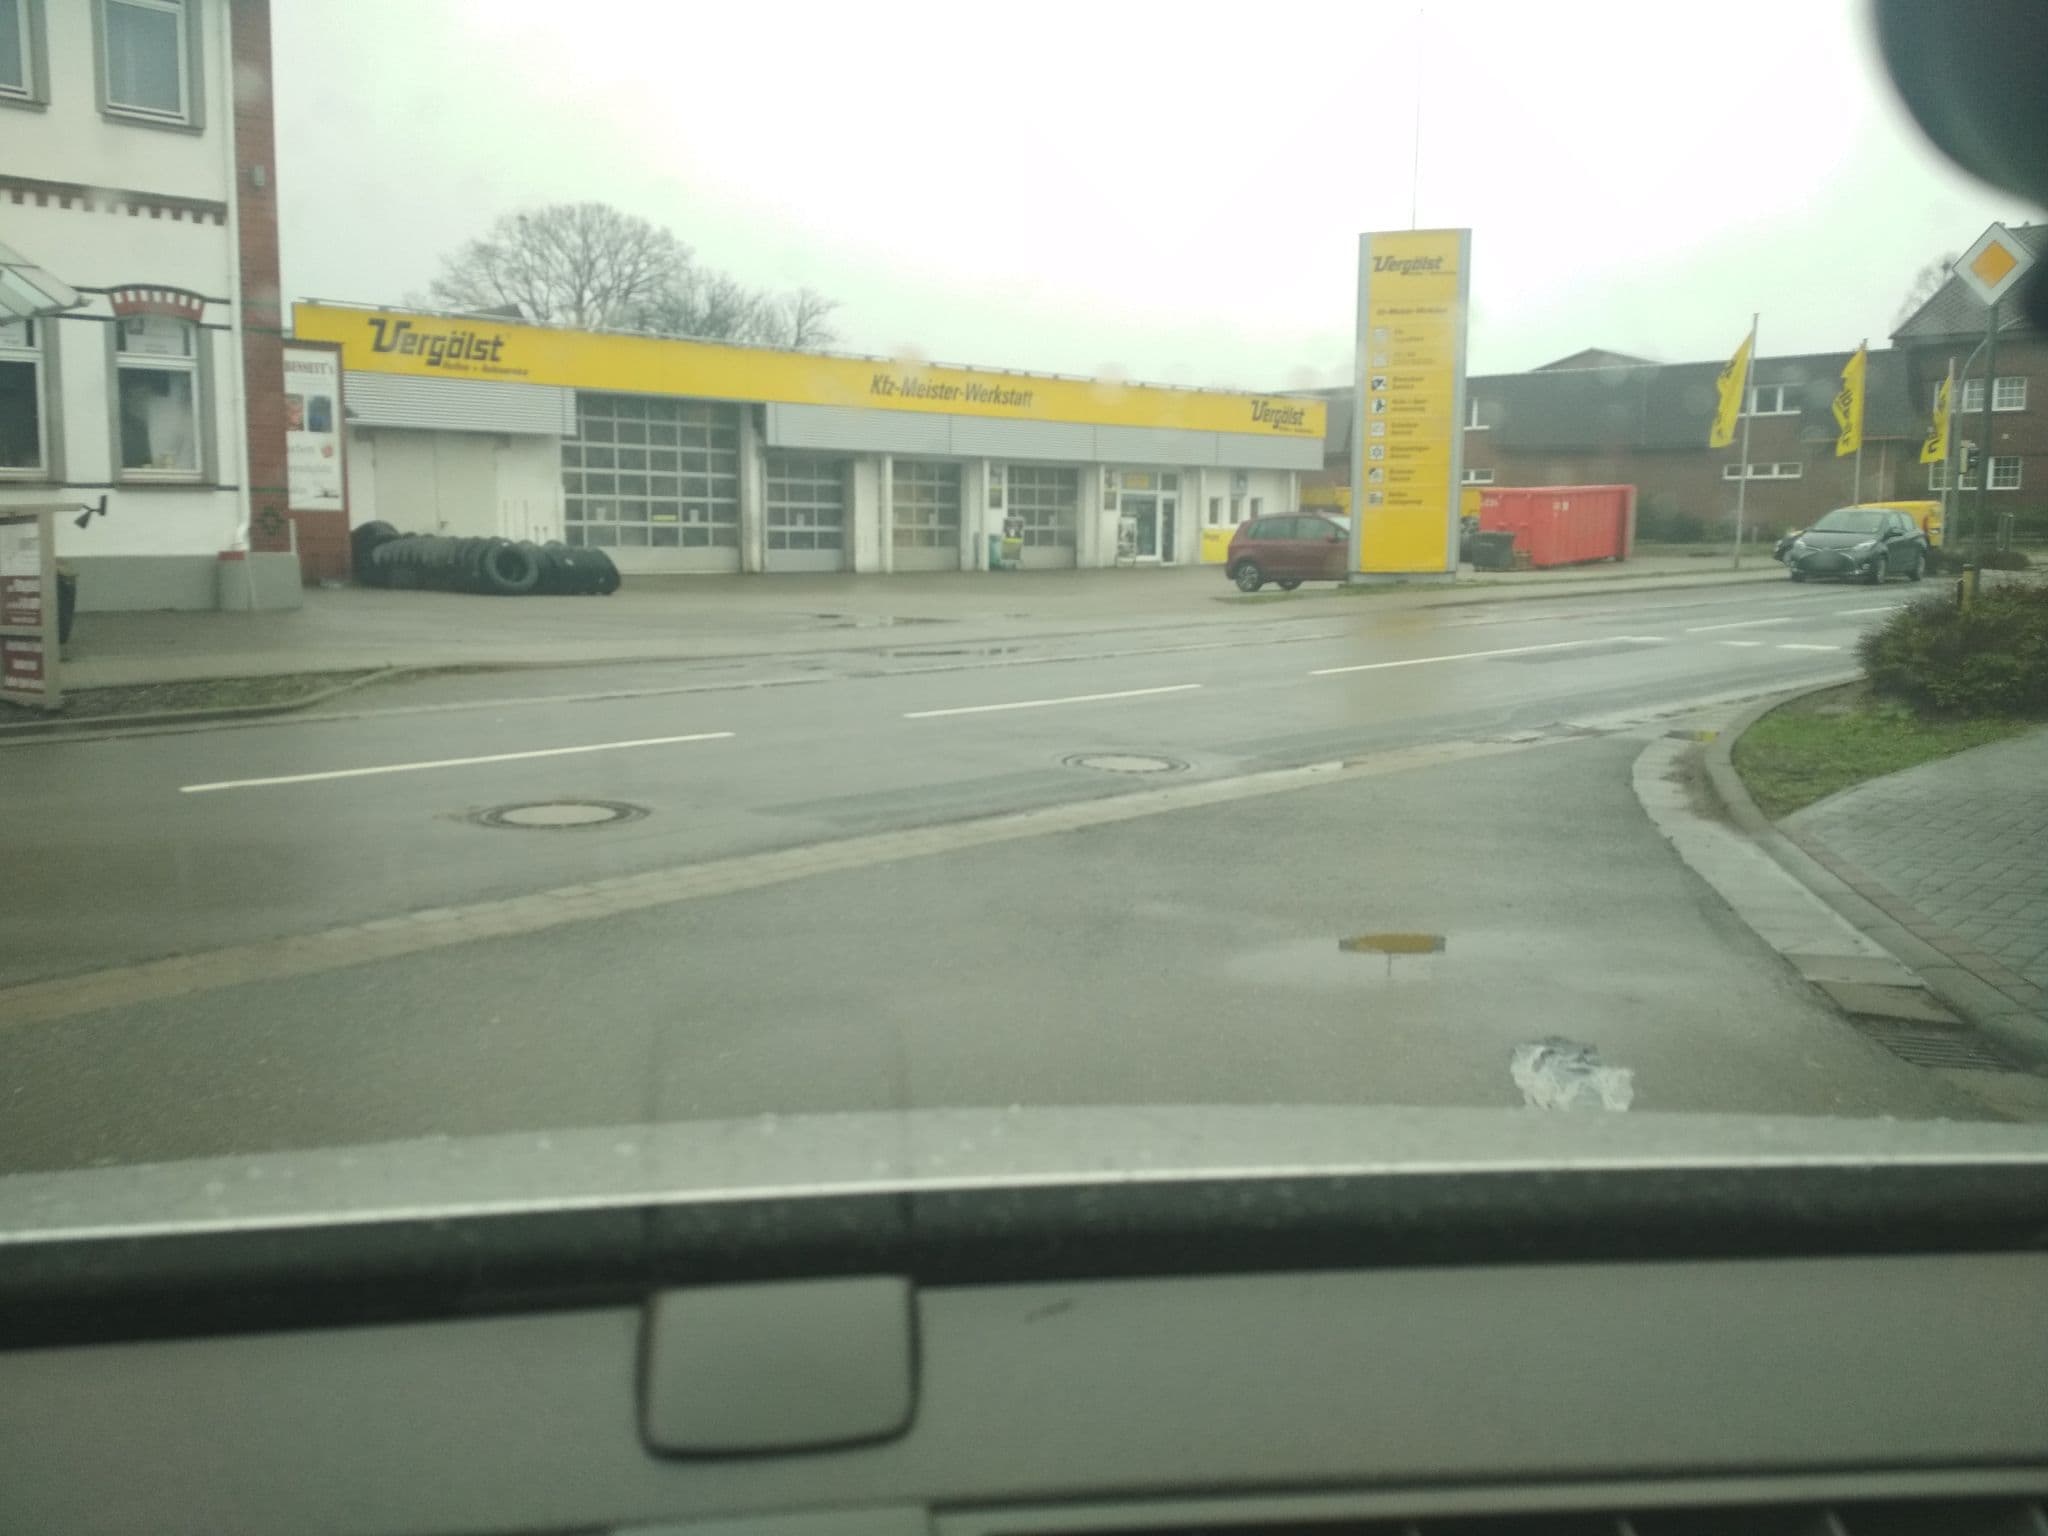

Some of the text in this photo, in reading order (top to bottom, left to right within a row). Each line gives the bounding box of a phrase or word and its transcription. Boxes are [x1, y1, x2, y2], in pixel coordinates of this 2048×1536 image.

[1372, 255, 1444, 276] Vergölst
[368, 318, 504, 366] Vergölst
[870, 374, 1033, 408] Kfz-Meister-Werkstatt
[1251, 399, 1305, 429] Vergölst
